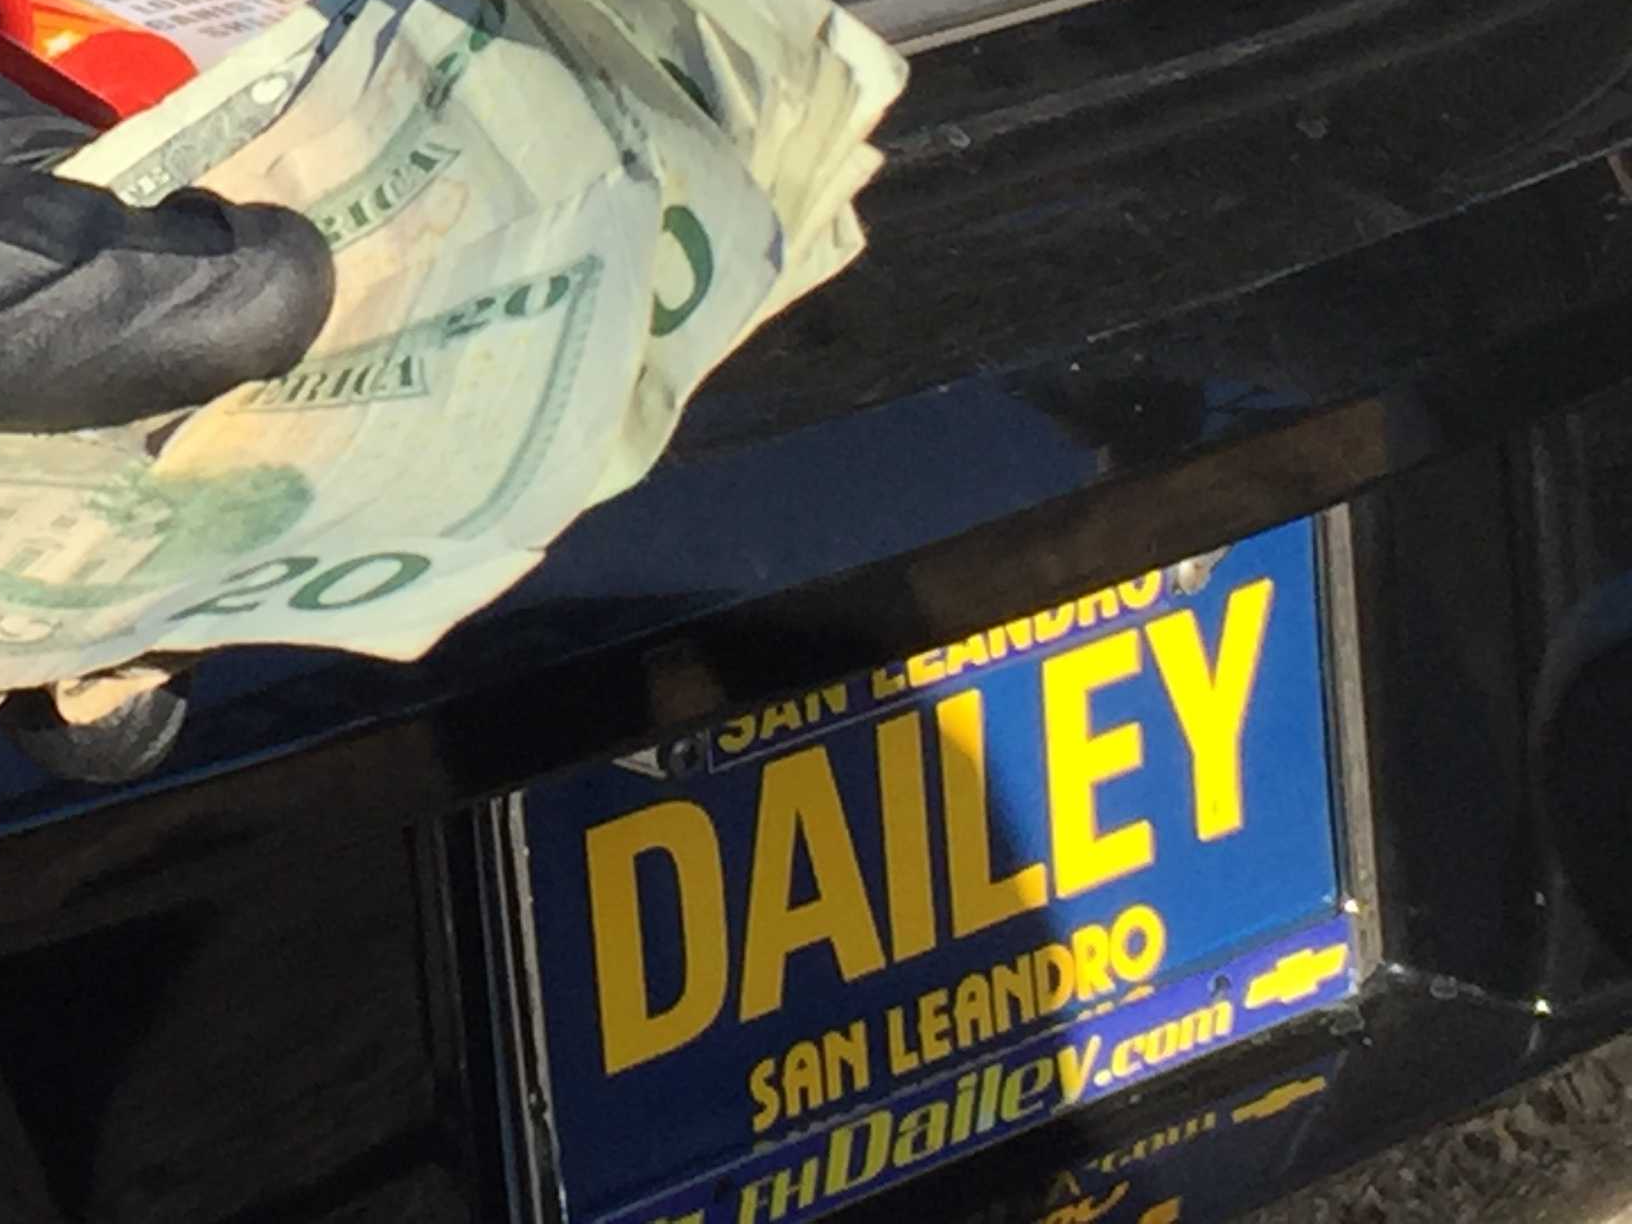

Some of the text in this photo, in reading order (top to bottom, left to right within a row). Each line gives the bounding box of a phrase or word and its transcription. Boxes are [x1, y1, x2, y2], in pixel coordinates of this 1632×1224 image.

[167, 551, 431, 623] 20
[584, 577, 1275, 1077] DAILEY
[748, 903, 1166, 1133] SAN LEANDRO
